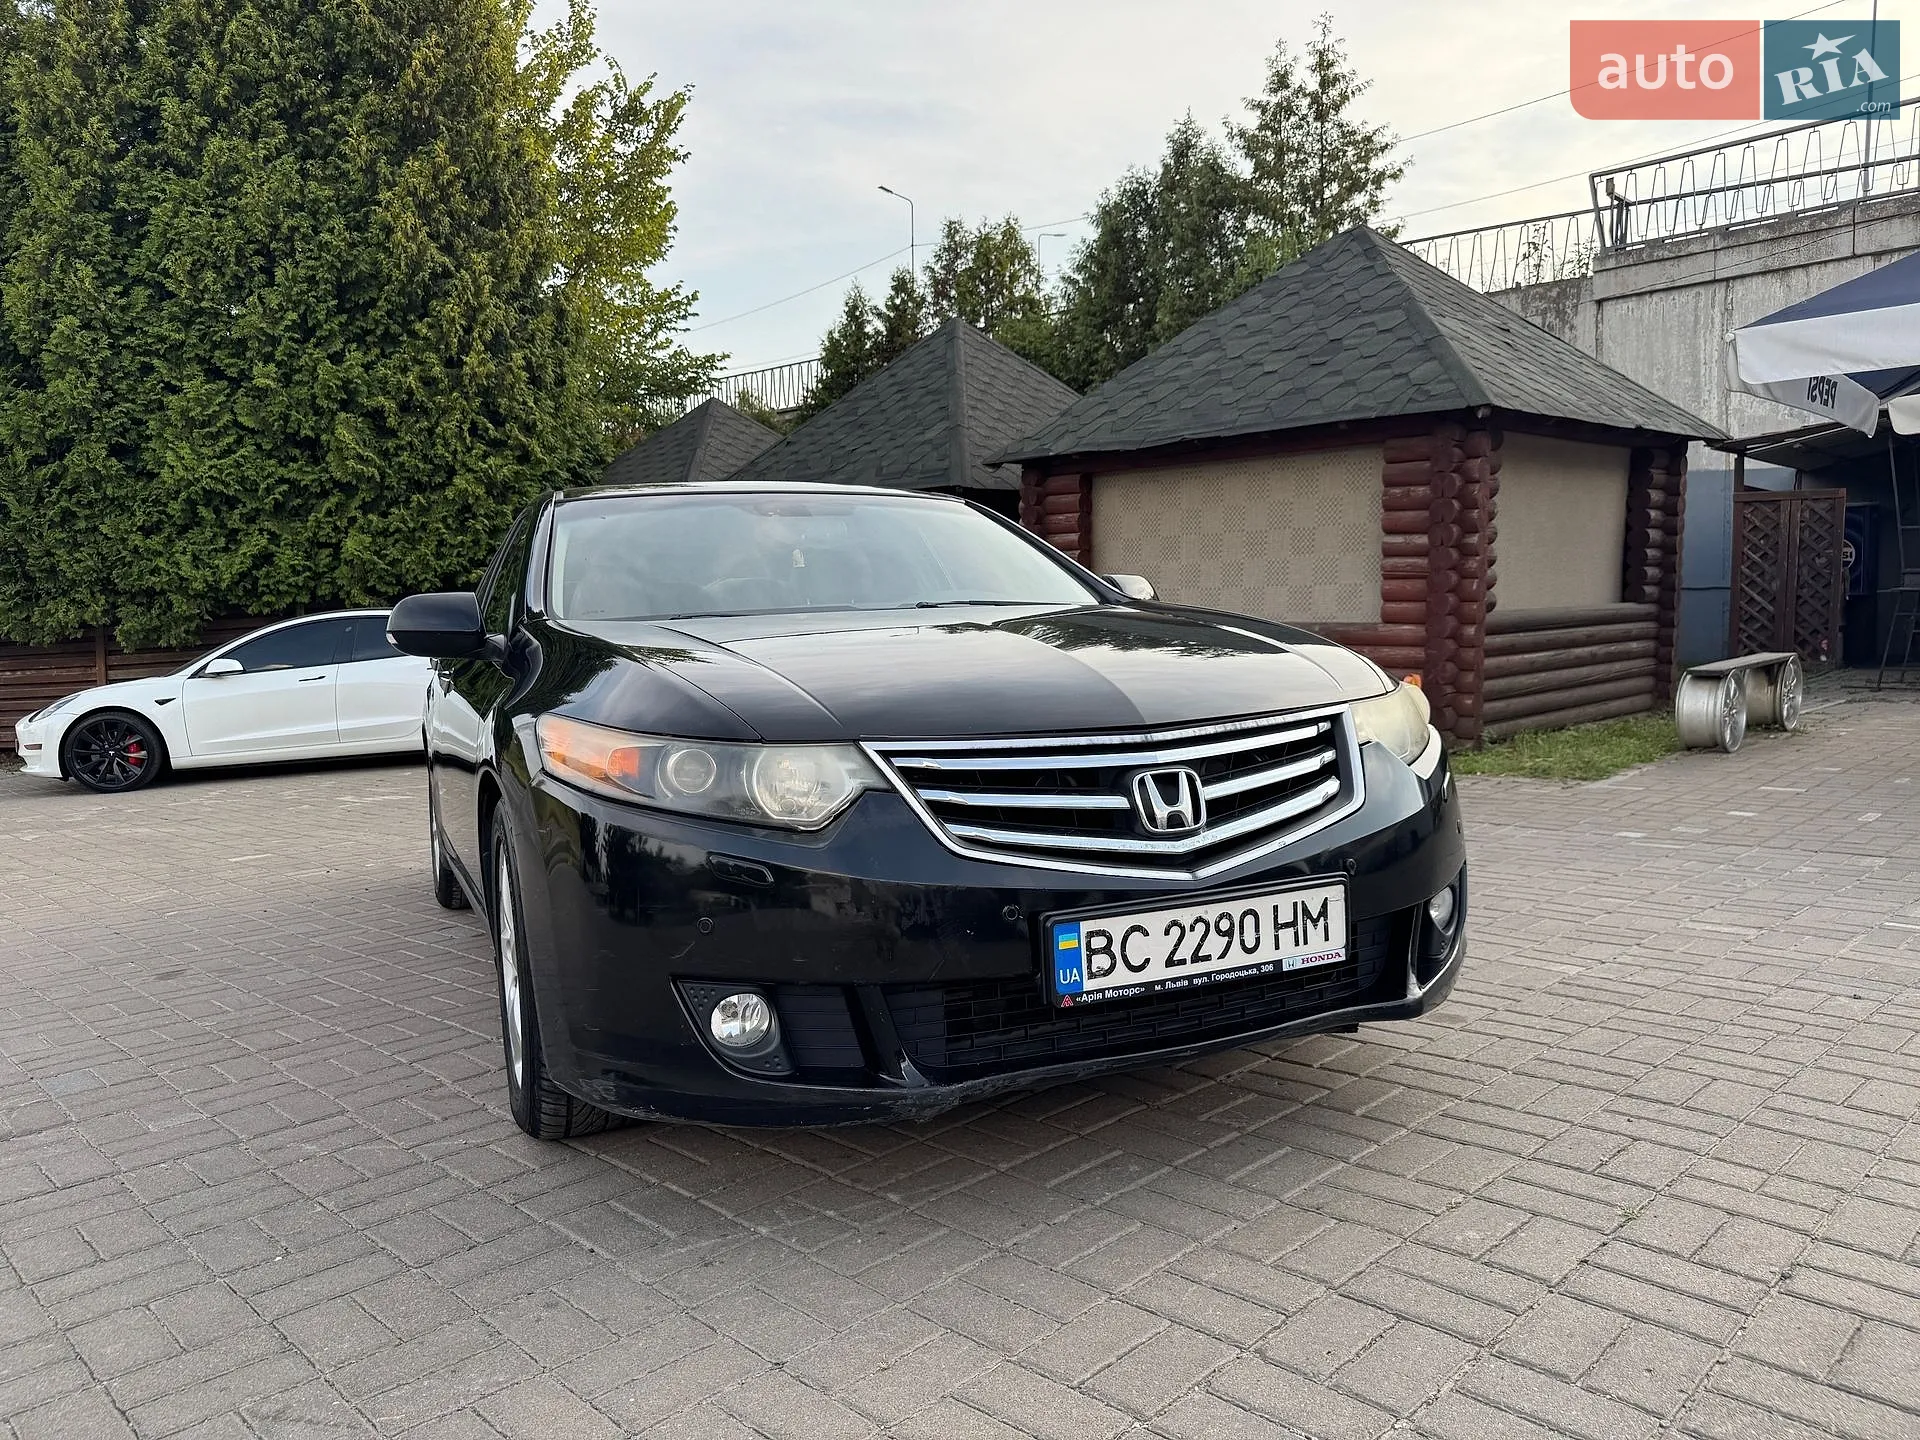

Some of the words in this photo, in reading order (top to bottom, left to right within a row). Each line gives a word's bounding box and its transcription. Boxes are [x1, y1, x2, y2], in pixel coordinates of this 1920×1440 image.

[1085, 924, 1151, 981] BC
[1163, 908, 1261, 969] 2290
[1272, 896, 1330, 951] HM
[1301, 951, 1343, 965] HONDA
[1060, 967, 1081, 985] UA
[1165, 979, 1189, 990] Львів
[1193, 974, 1210, 986] вул.
[1211, 968, 1259, 982] Городоцька,
